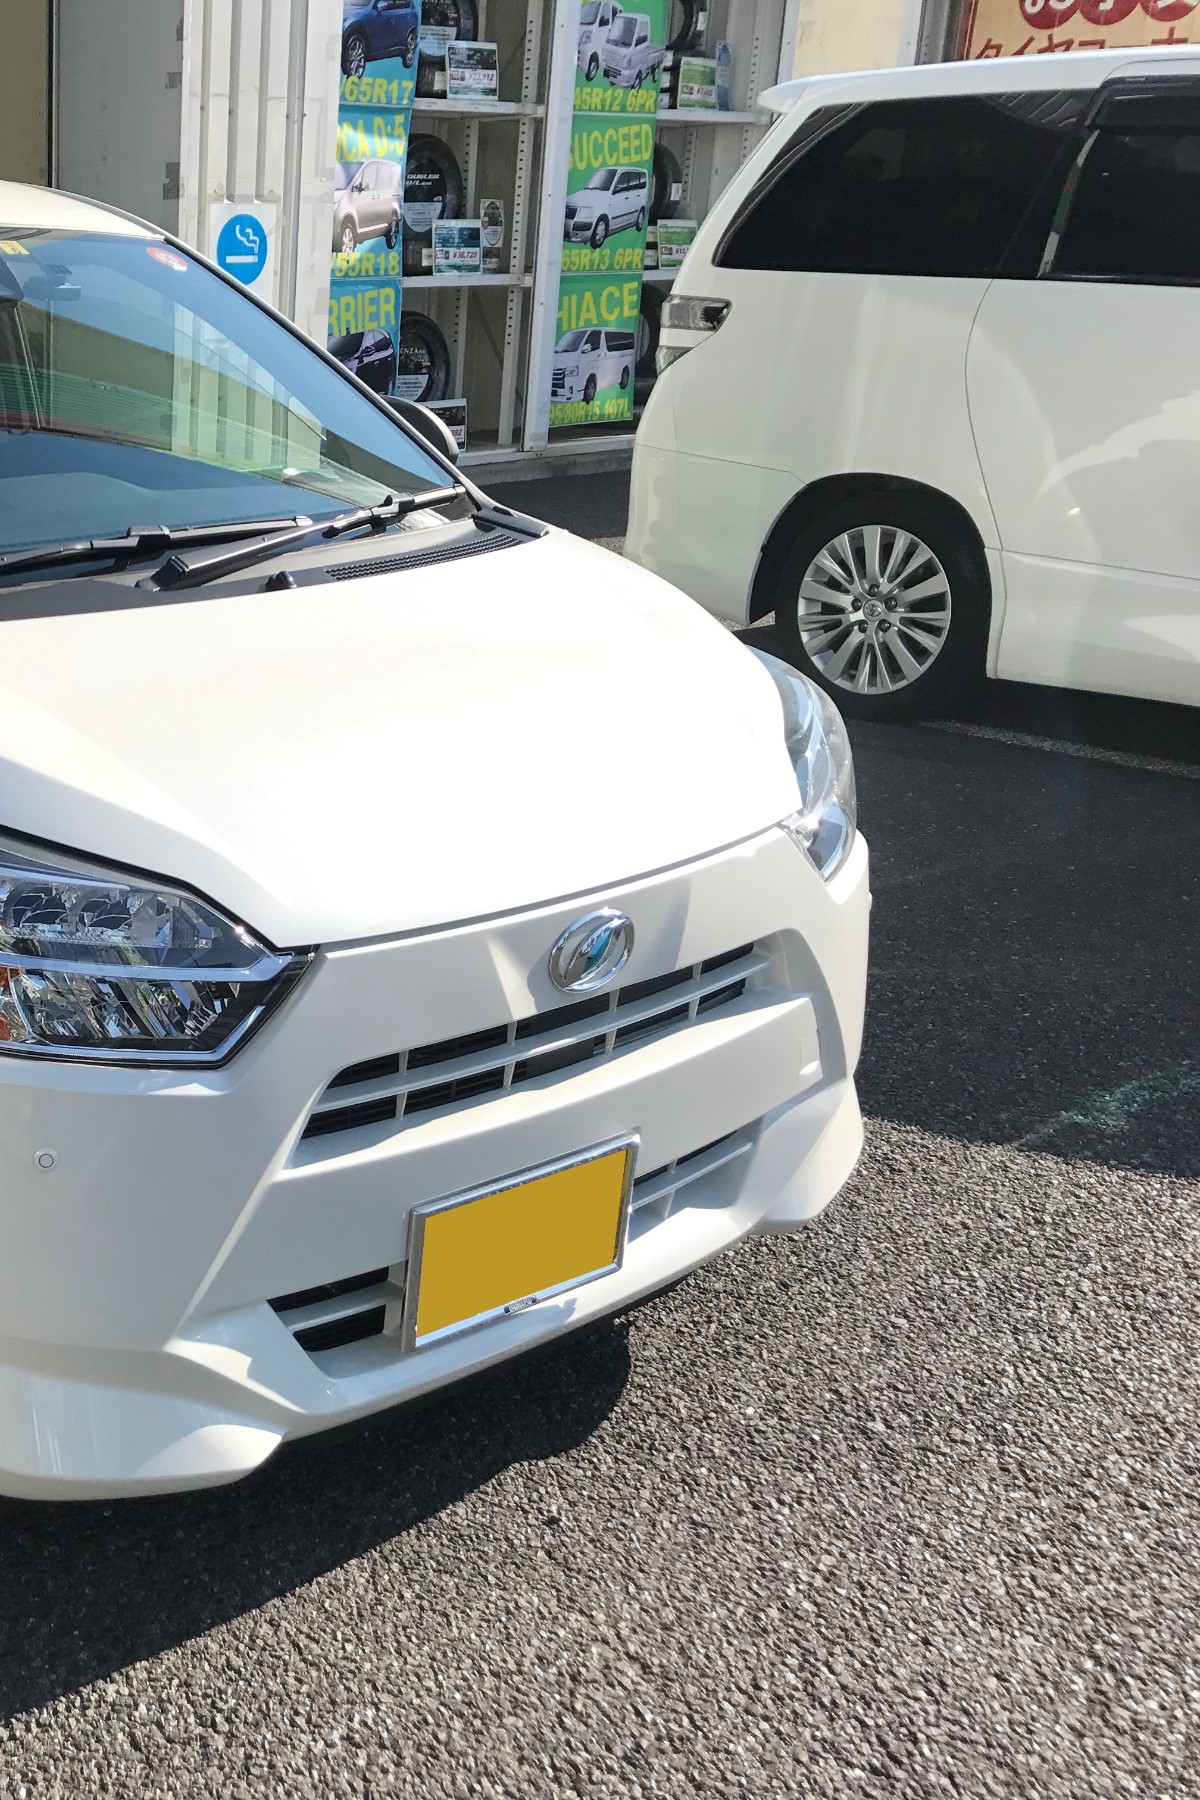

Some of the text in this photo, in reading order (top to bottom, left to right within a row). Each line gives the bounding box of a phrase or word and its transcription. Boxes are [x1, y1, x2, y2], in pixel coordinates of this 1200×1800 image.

[626, 89, 655, 112] 6PR
[373, 114, 408, 158] D:5
[613, 248, 643, 270] 6PR
